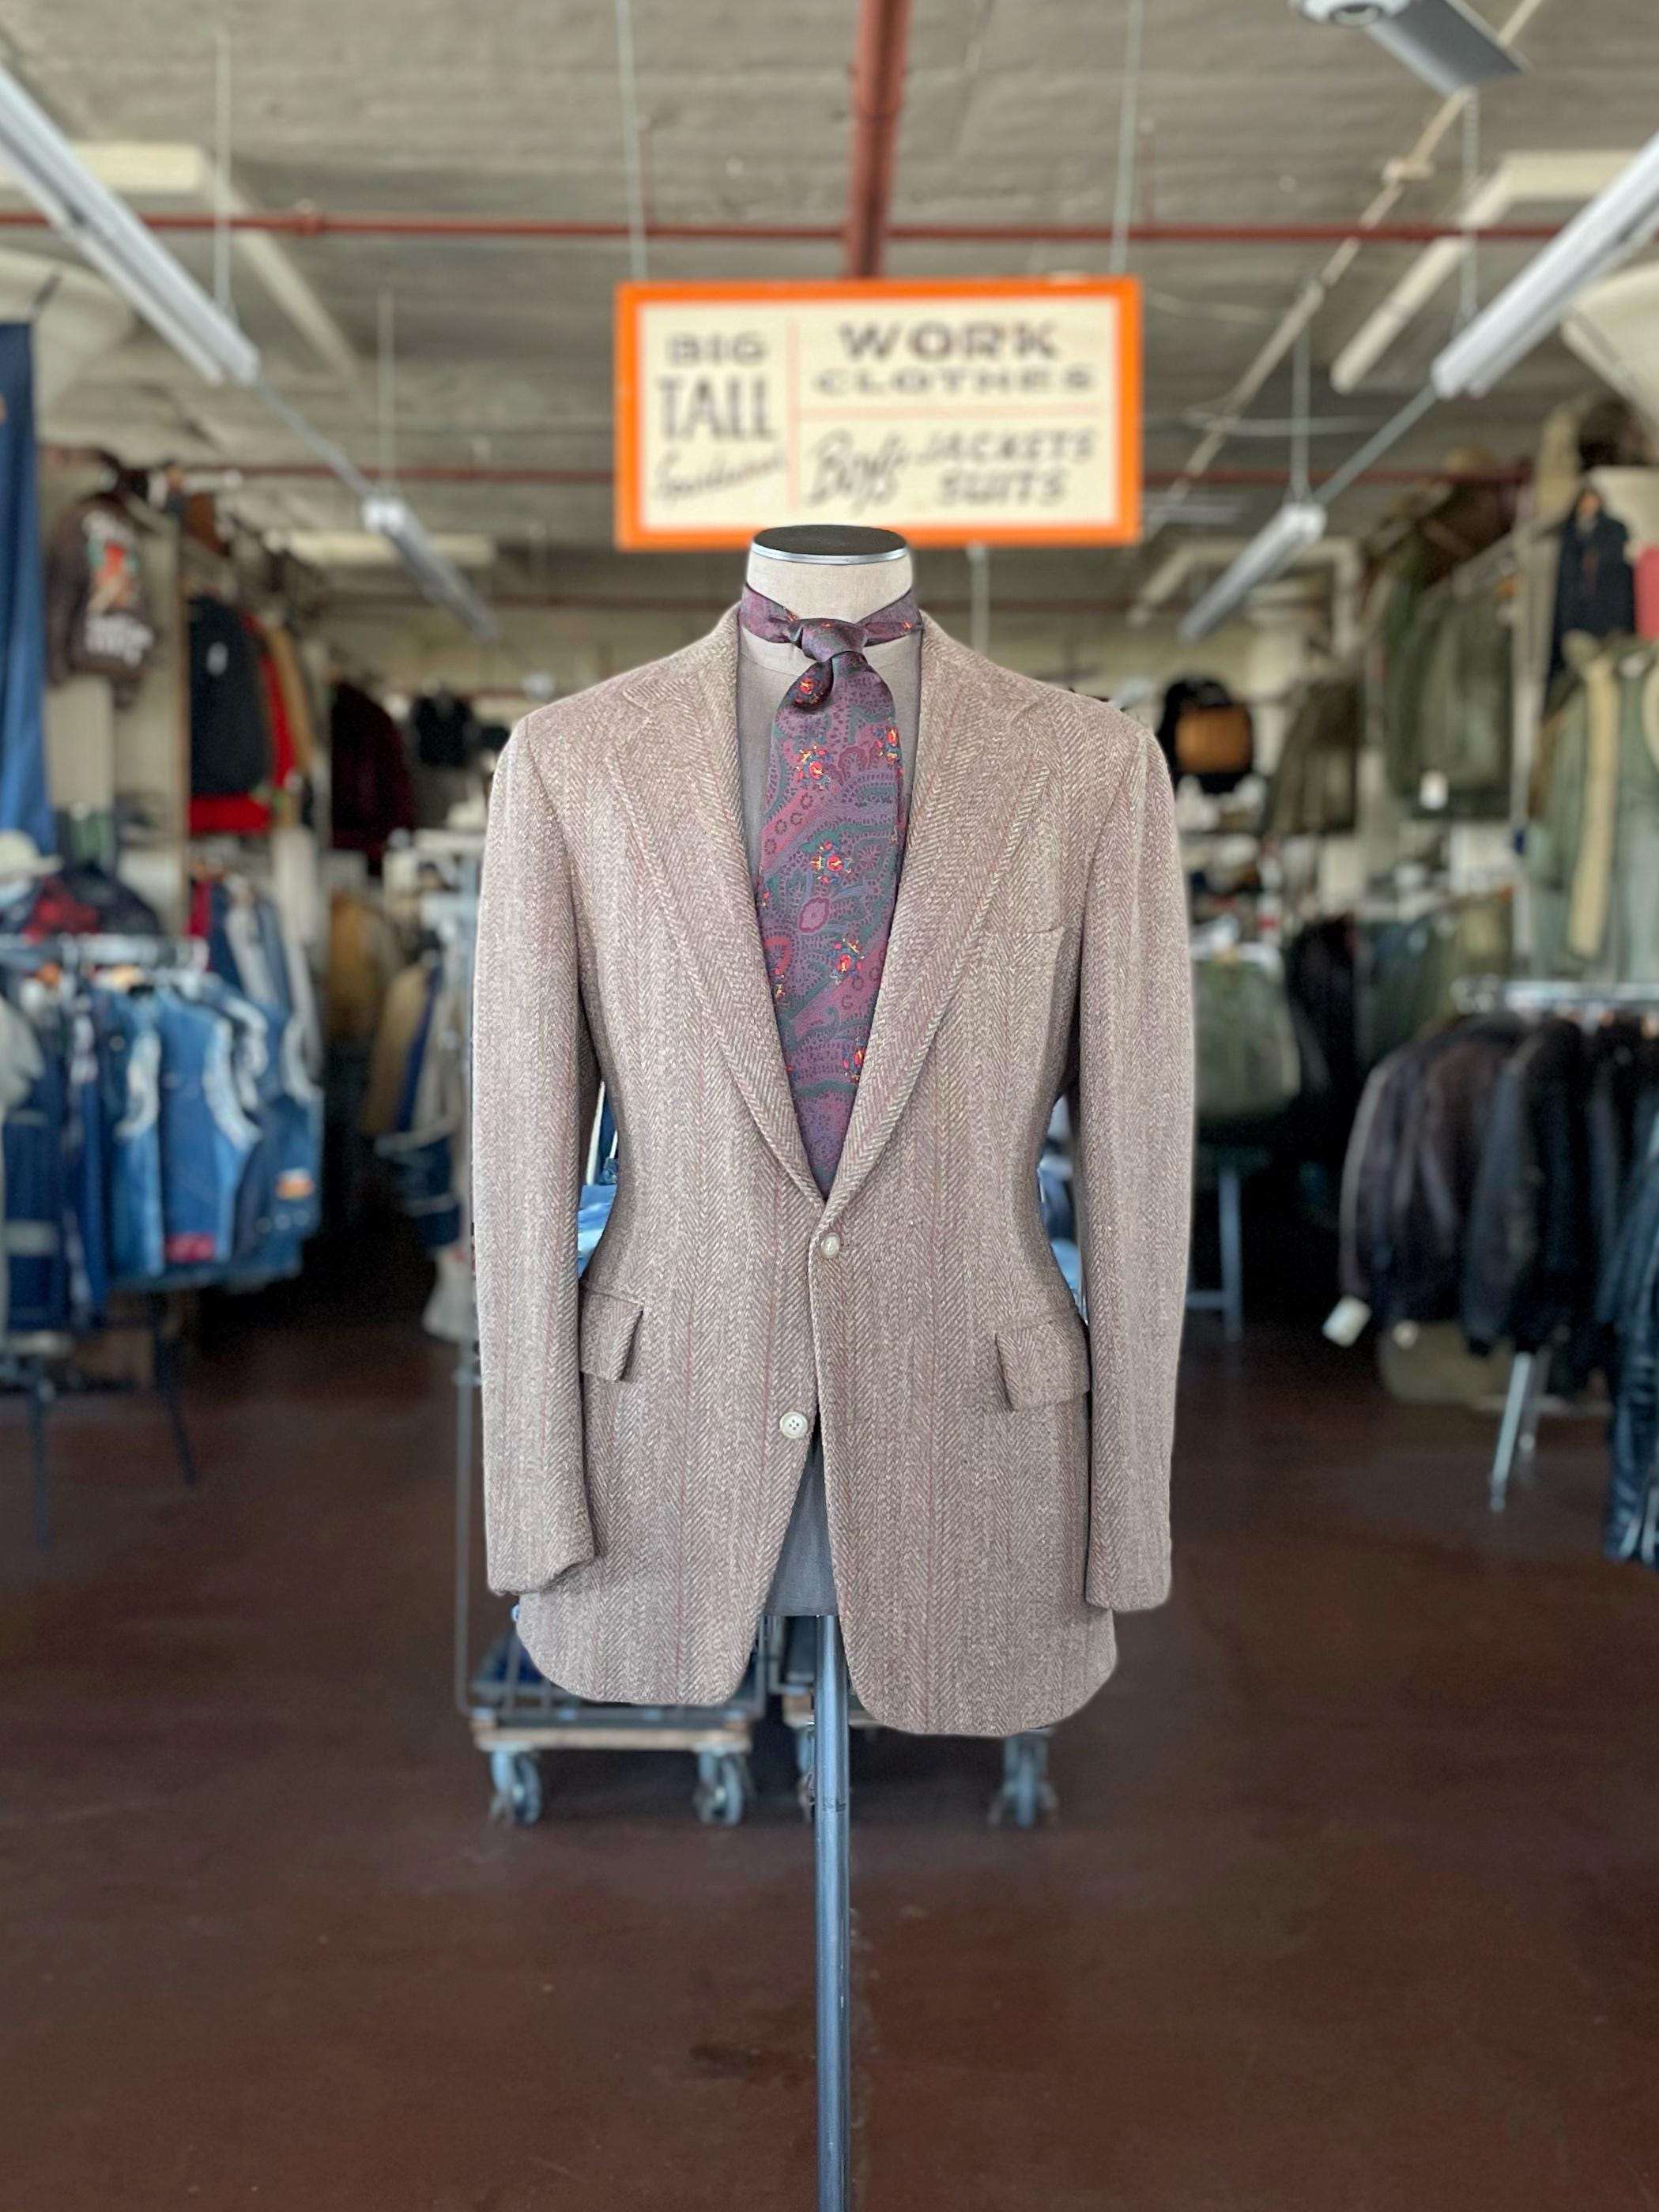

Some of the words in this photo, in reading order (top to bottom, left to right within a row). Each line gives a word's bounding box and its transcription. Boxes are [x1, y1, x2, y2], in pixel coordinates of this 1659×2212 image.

[666, 332, 767, 366] BIG
[839, 321, 1058, 361] WORK
[813, 360, 1093, 396] CLOTHES
[657, 375, 777, 441] TALL
[916, 428, 1097, 466] JACKETS
[937, 468, 1069, 507] SUITS
